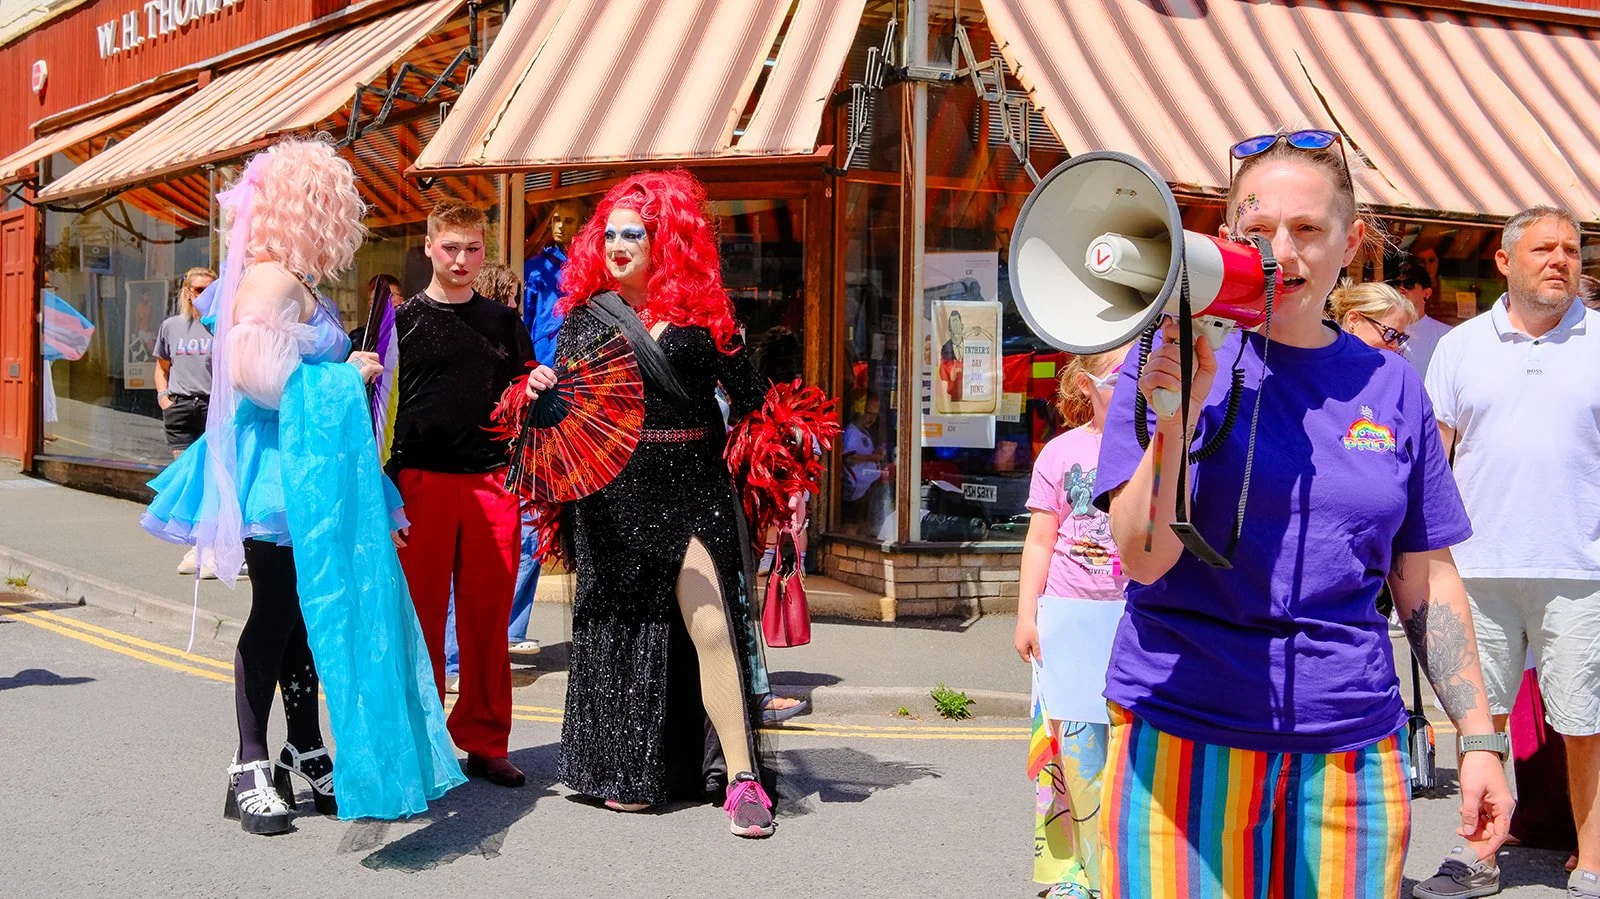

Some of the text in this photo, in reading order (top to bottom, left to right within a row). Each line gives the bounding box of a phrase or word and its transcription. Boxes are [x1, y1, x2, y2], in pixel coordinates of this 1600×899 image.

[144, 0, 244, 39] THOM
[176, 338, 211, 355] LOV
[964, 346, 990, 355] FATHER'S
[971, 359, 982, 367] DAY
[970, 385, 985, 395] JUNE
